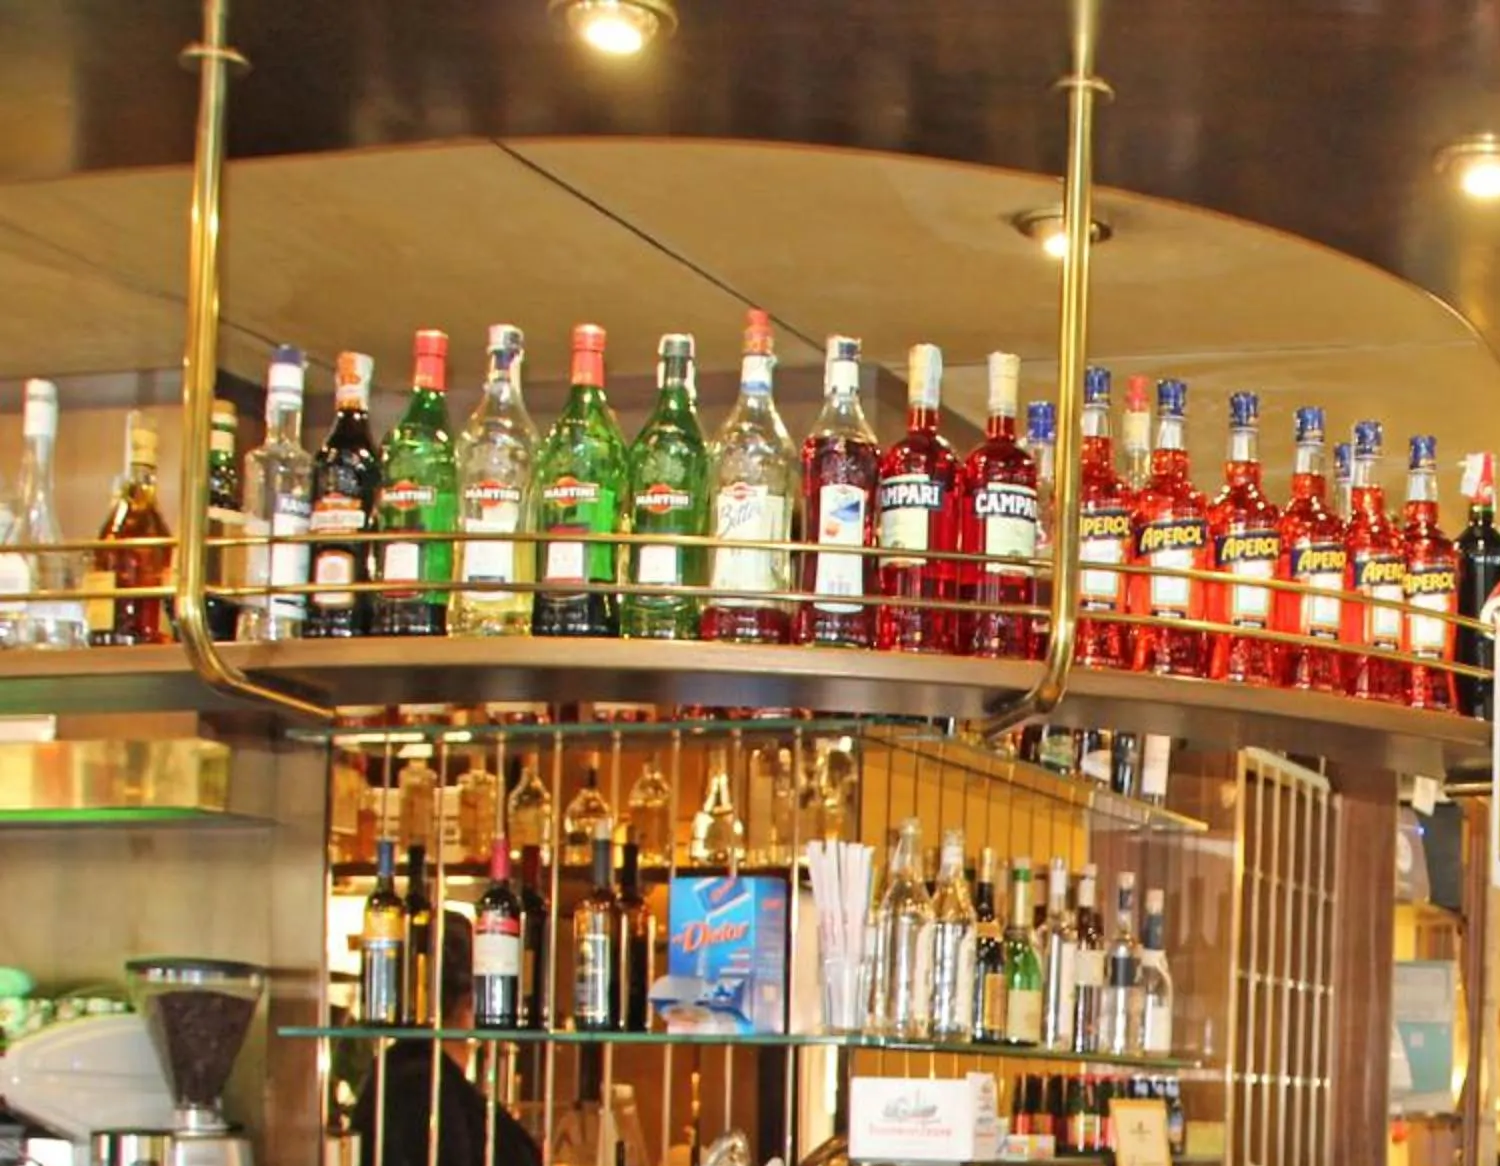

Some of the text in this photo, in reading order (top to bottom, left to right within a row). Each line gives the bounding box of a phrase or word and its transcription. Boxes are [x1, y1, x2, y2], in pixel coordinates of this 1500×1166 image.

[382, 489, 434, 502] MARTINI
[465, 488, 520, 501] MARTINI
[543, 486, 595, 499] MARTINI
[635, 494, 689, 507] MARTINI
[975, 492, 1037, 518] CAMPA
[1140, 526, 1203, 552] APEROL
[1298, 549, 1347, 572] APERO
